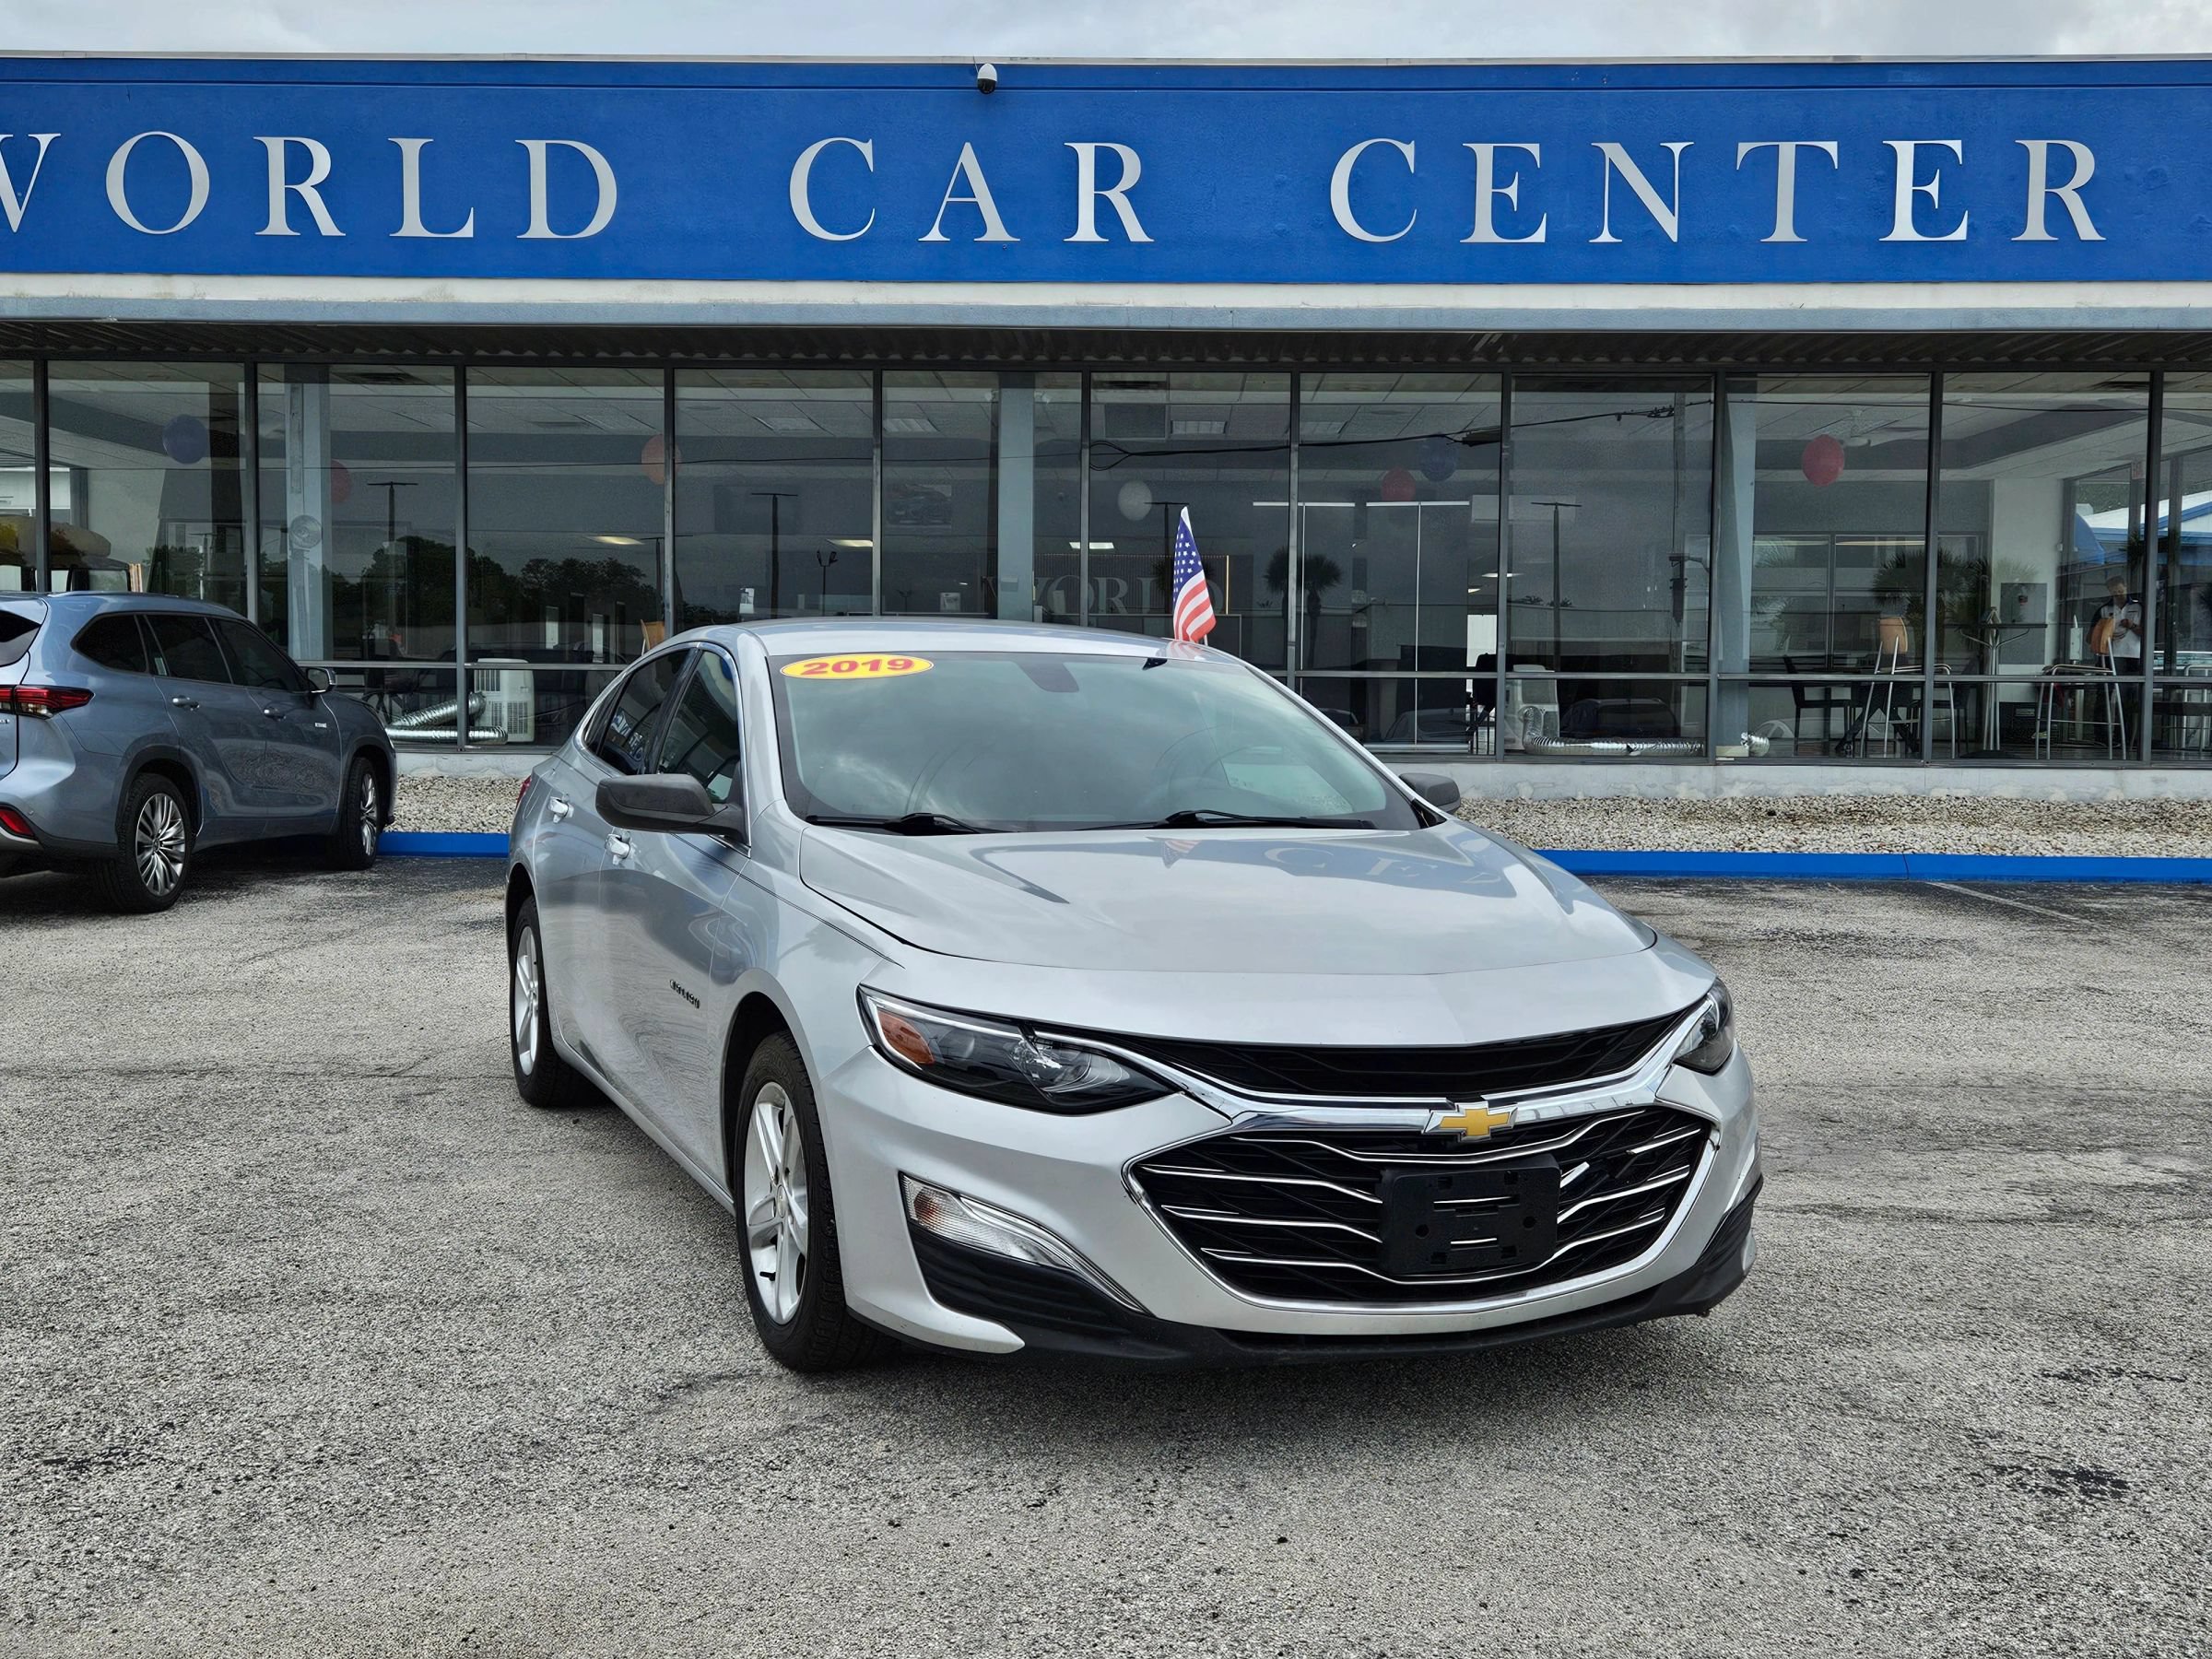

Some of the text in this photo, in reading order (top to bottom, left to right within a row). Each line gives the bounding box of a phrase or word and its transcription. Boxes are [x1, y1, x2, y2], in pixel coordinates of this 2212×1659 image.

[790, 137, 1155, 241] CAR
[1330, 138, 2106, 242] CENTER
[801, 658, 914, 676] 2019
